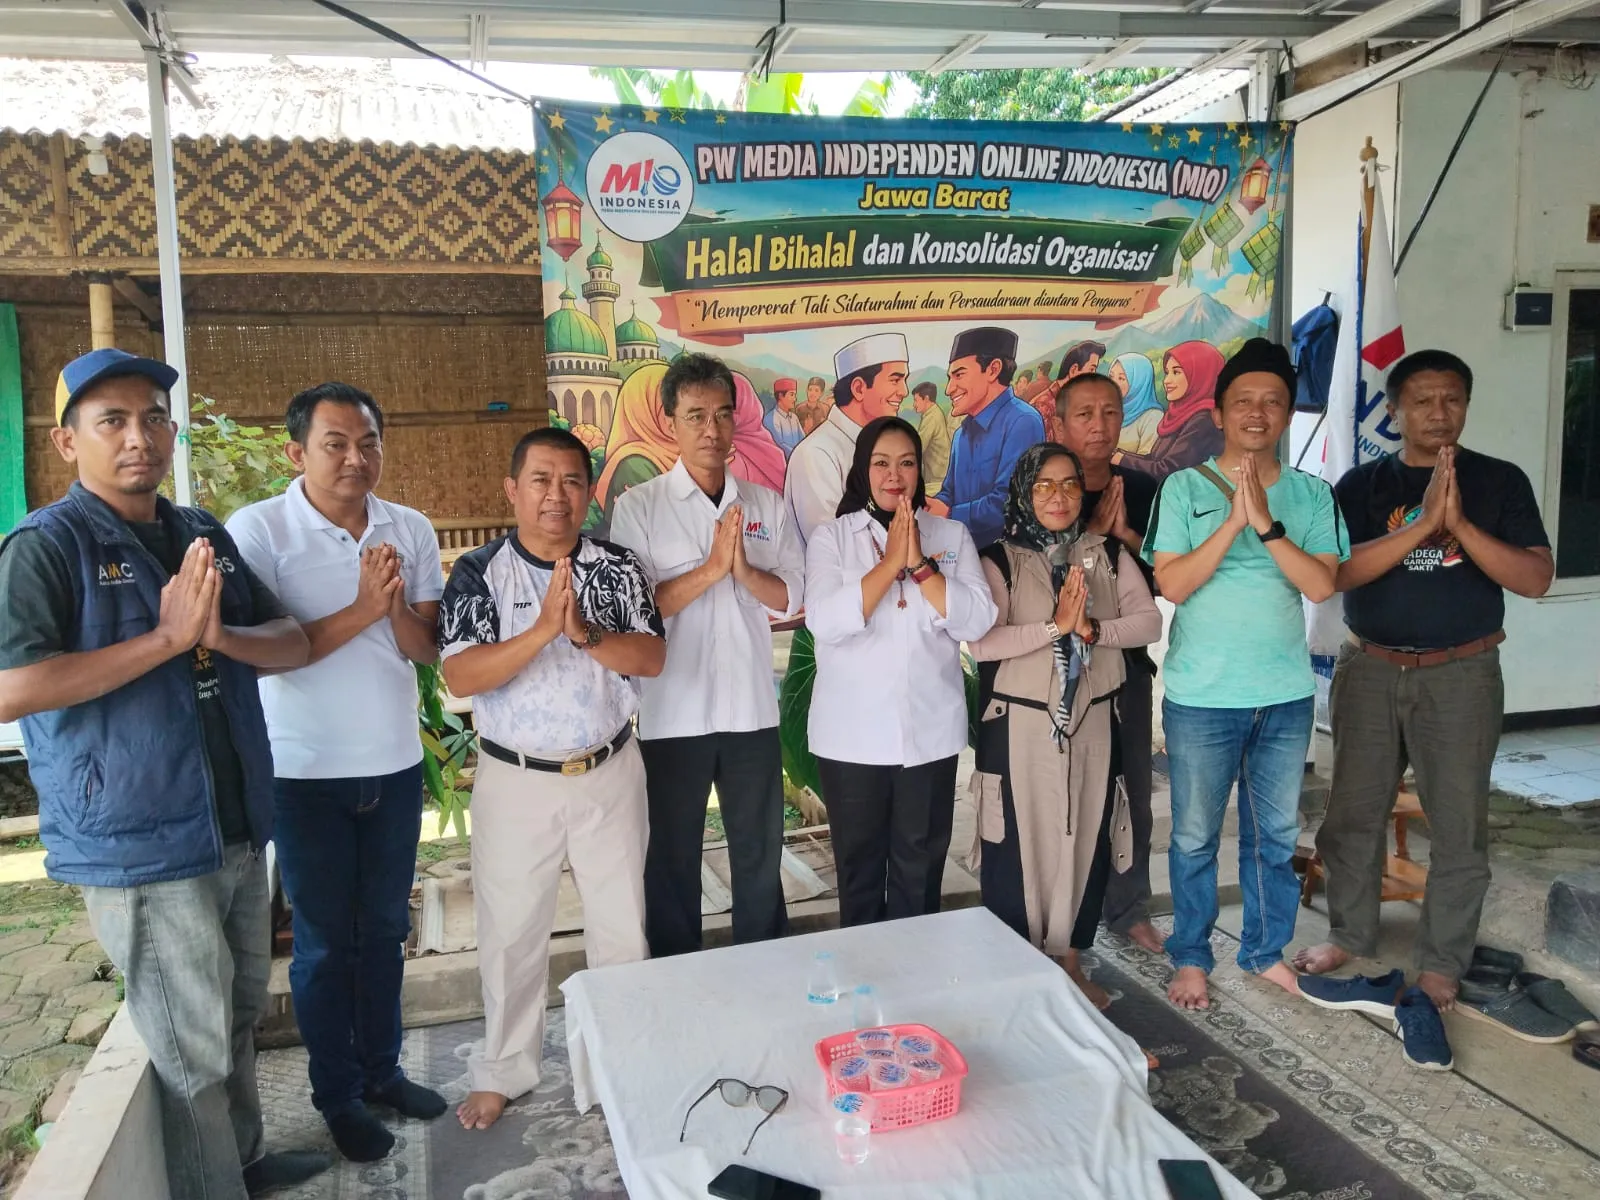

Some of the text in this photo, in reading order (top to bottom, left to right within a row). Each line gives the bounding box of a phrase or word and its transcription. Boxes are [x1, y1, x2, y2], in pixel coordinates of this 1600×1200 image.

[600, 159, 681, 196] MIO
[697, 143, 1228, 202] PW MEDIA INDEPENDEN ONLINE INDONESIA (MIO)
[600, 197, 680, 209] INDONESIA
[860, 183, 1010, 210] Jawa Barat
[686, 230, 1159, 280] Halal Bihalal dan Konsolidasi Organisasi
[800, 295, 831, 315] Tali
[832, 290, 917, 315] Silaturahmi
[920, 289, 945, 310] dan
[949, 288, 1031, 310] Persaudaraan
[1032, 289, 1080, 307] diantara
[1403, 558, 1440, 566] GARUDA
[1407, 549, 1443, 560] ADEGA
[98, 562, 133, 580] AMC
